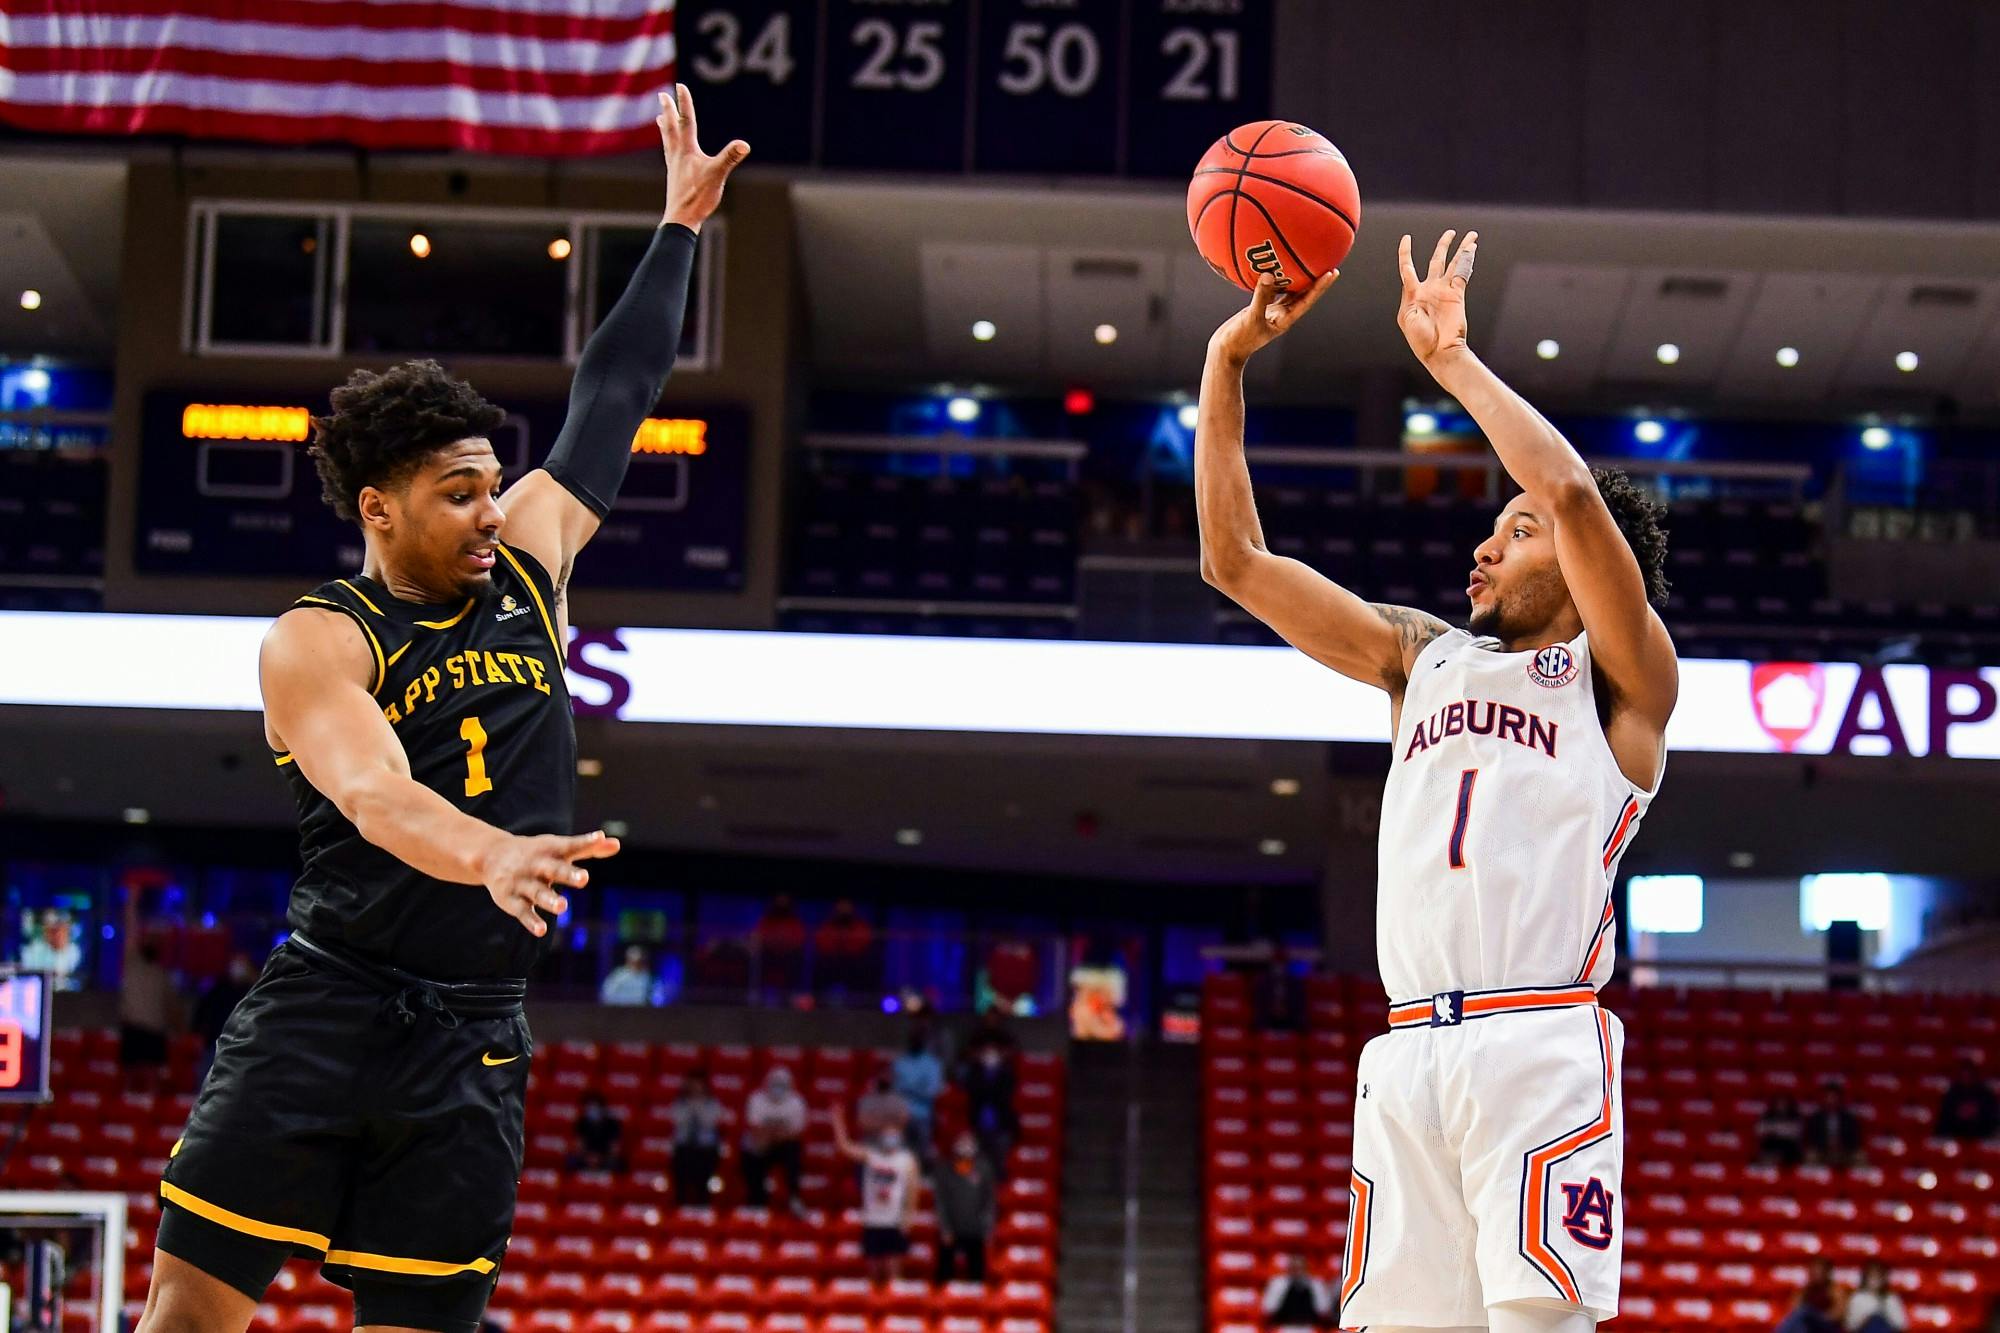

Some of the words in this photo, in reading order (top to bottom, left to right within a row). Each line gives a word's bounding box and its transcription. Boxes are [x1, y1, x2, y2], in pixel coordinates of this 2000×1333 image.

[694, 12, 794, 82] 34
[851, 20, 945, 89] 25
[998, 23, 1099, 95] 50
[1162, 30, 1240, 99] 21
[446, 650, 550, 695] STATE
[1531, 671, 1571, 687] GRADUATE
[1537, 647, 1569, 676] SEC
[460, 716, 493, 797] 1
[1403, 699, 1559, 763] AUBURN
[1447, 768, 1479, 870] 1
